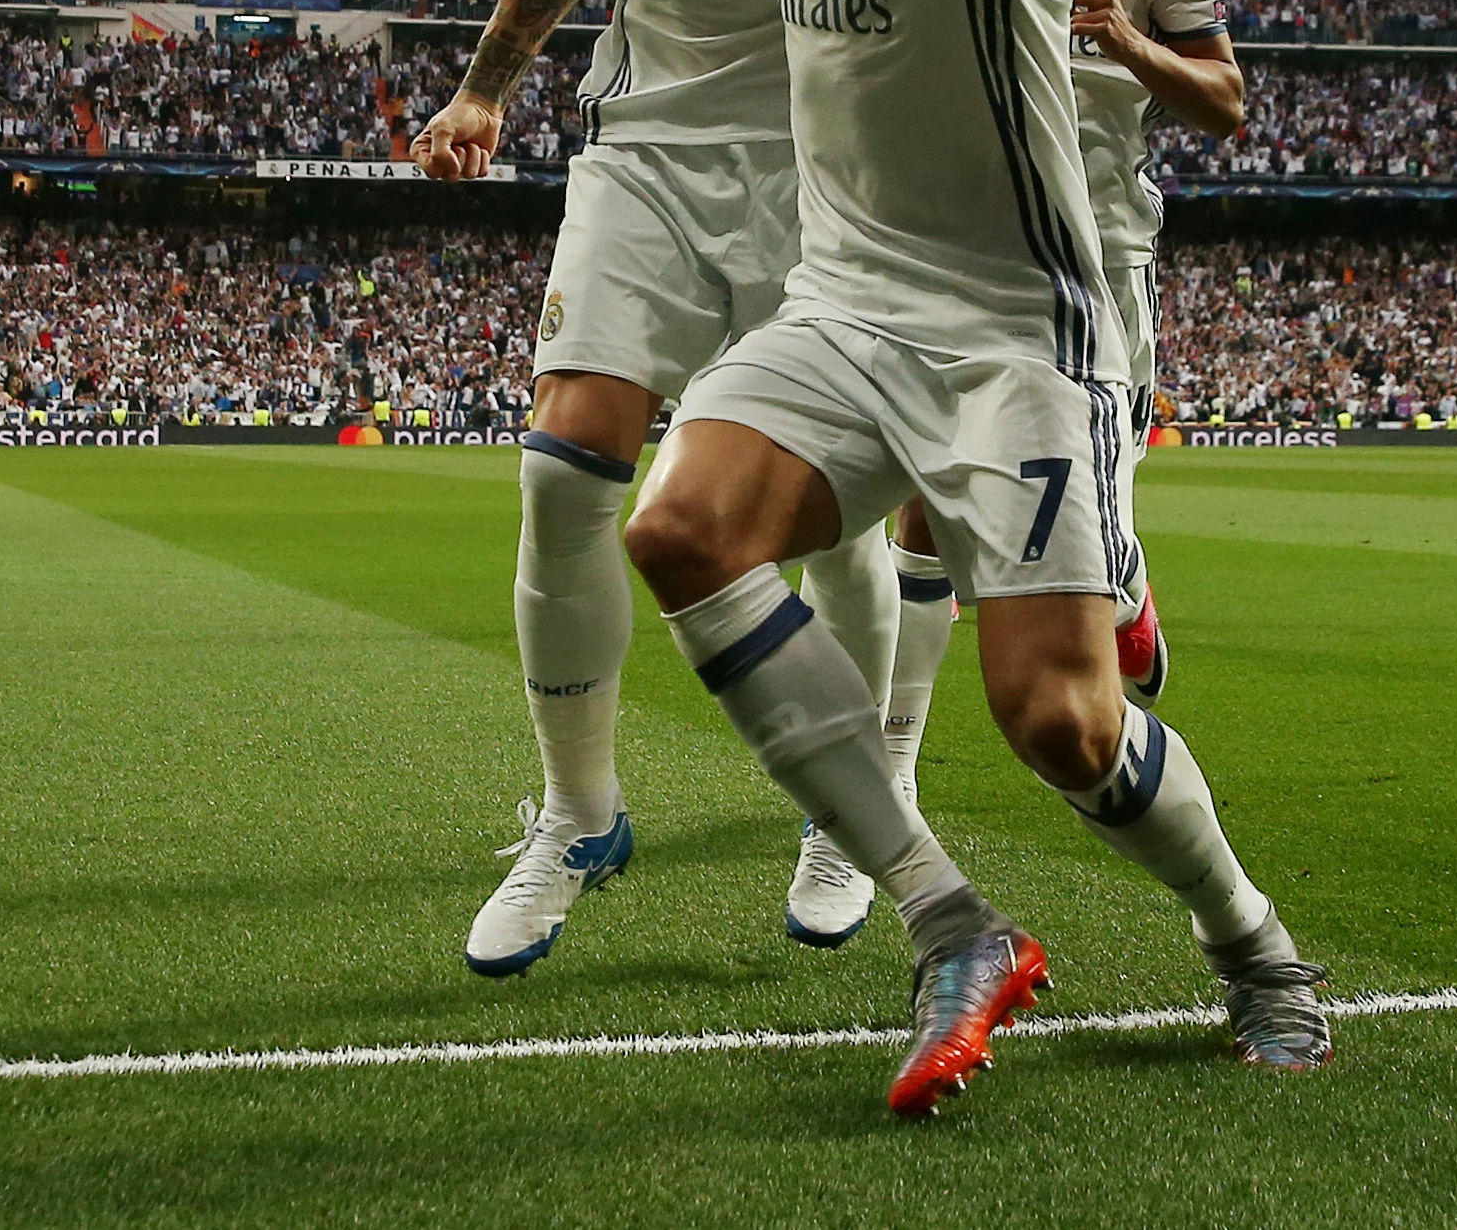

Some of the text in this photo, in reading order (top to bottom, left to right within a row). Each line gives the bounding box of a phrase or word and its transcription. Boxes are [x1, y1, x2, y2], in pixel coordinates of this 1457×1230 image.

[367, 165, 393, 178] LA
[1192, 426, 1337, 447] priceless
[1019, 457, 1073, 564] 7
[526, 677, 600, 698] RMCF
